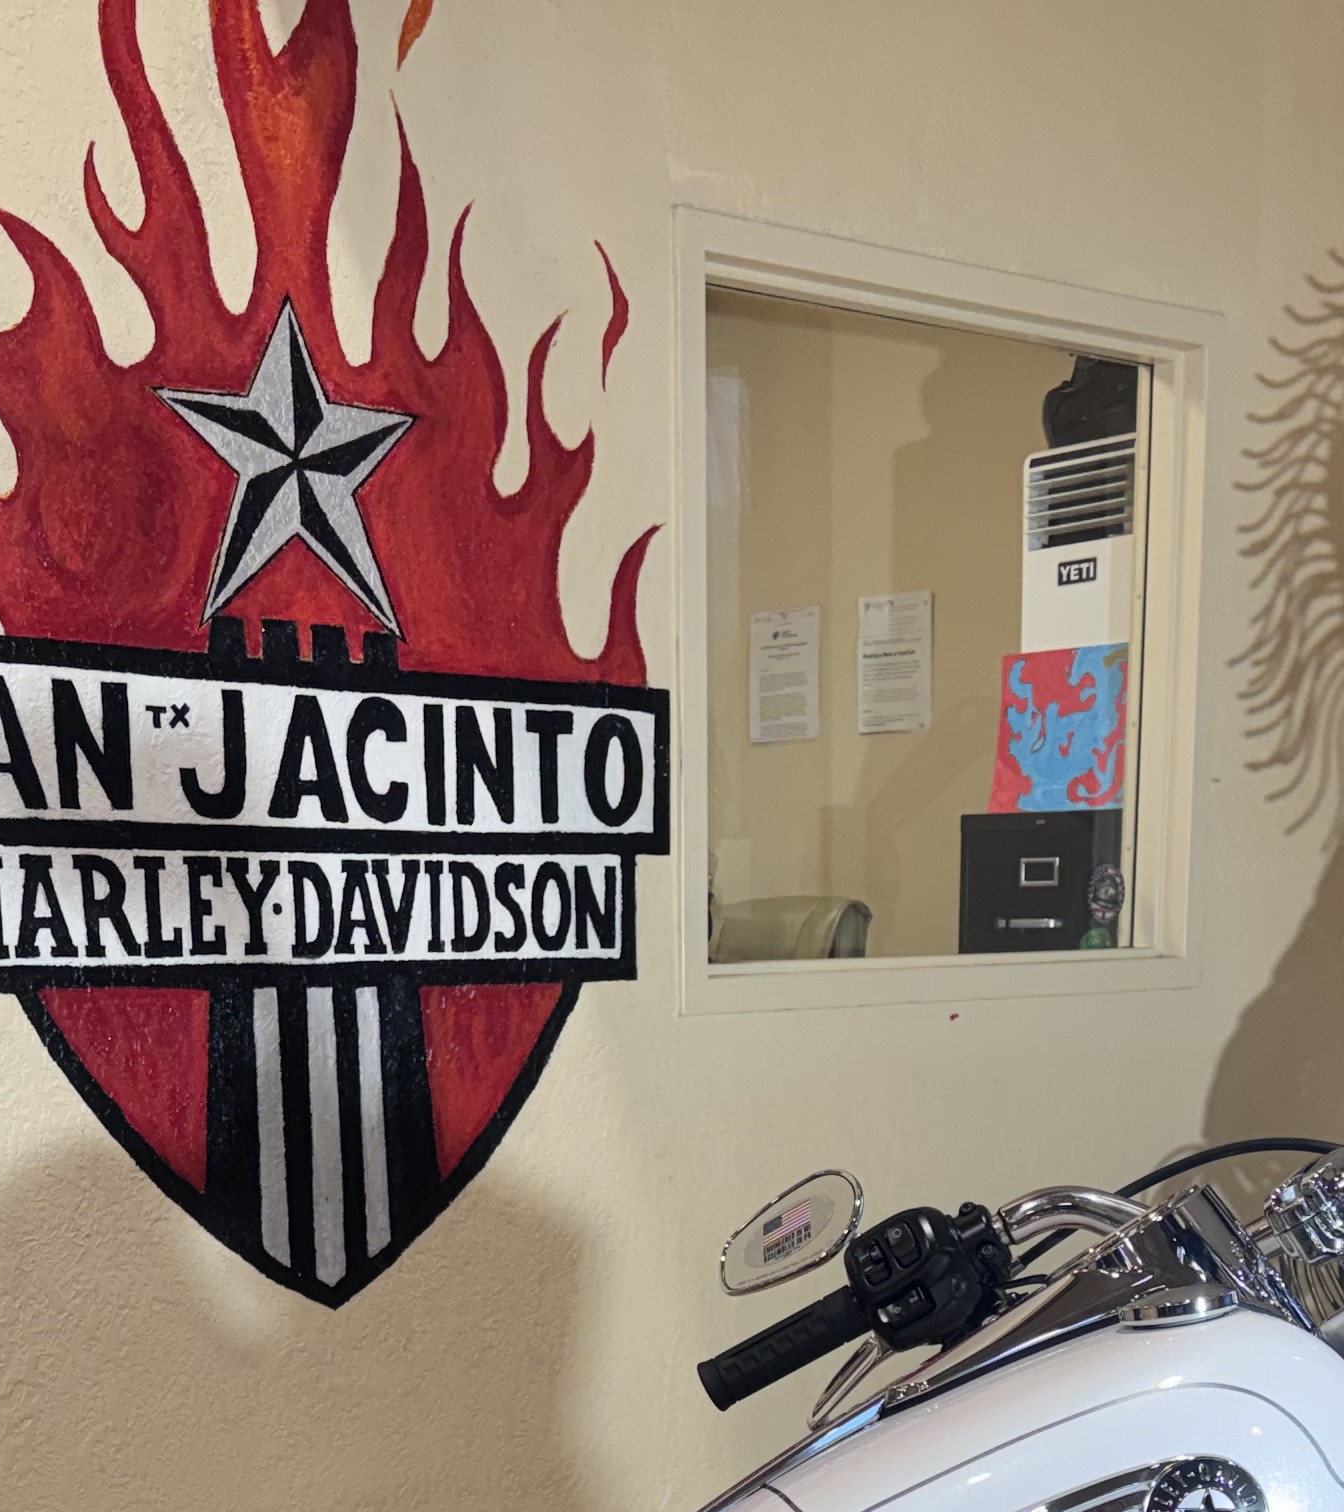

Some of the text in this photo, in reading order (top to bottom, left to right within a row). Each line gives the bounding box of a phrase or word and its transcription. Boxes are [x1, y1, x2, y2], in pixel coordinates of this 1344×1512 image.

[1060, 561, 1095, 582] YETI
[146, 704, 191, 729] TX
[180, 689, 646, 828] JACINTO
